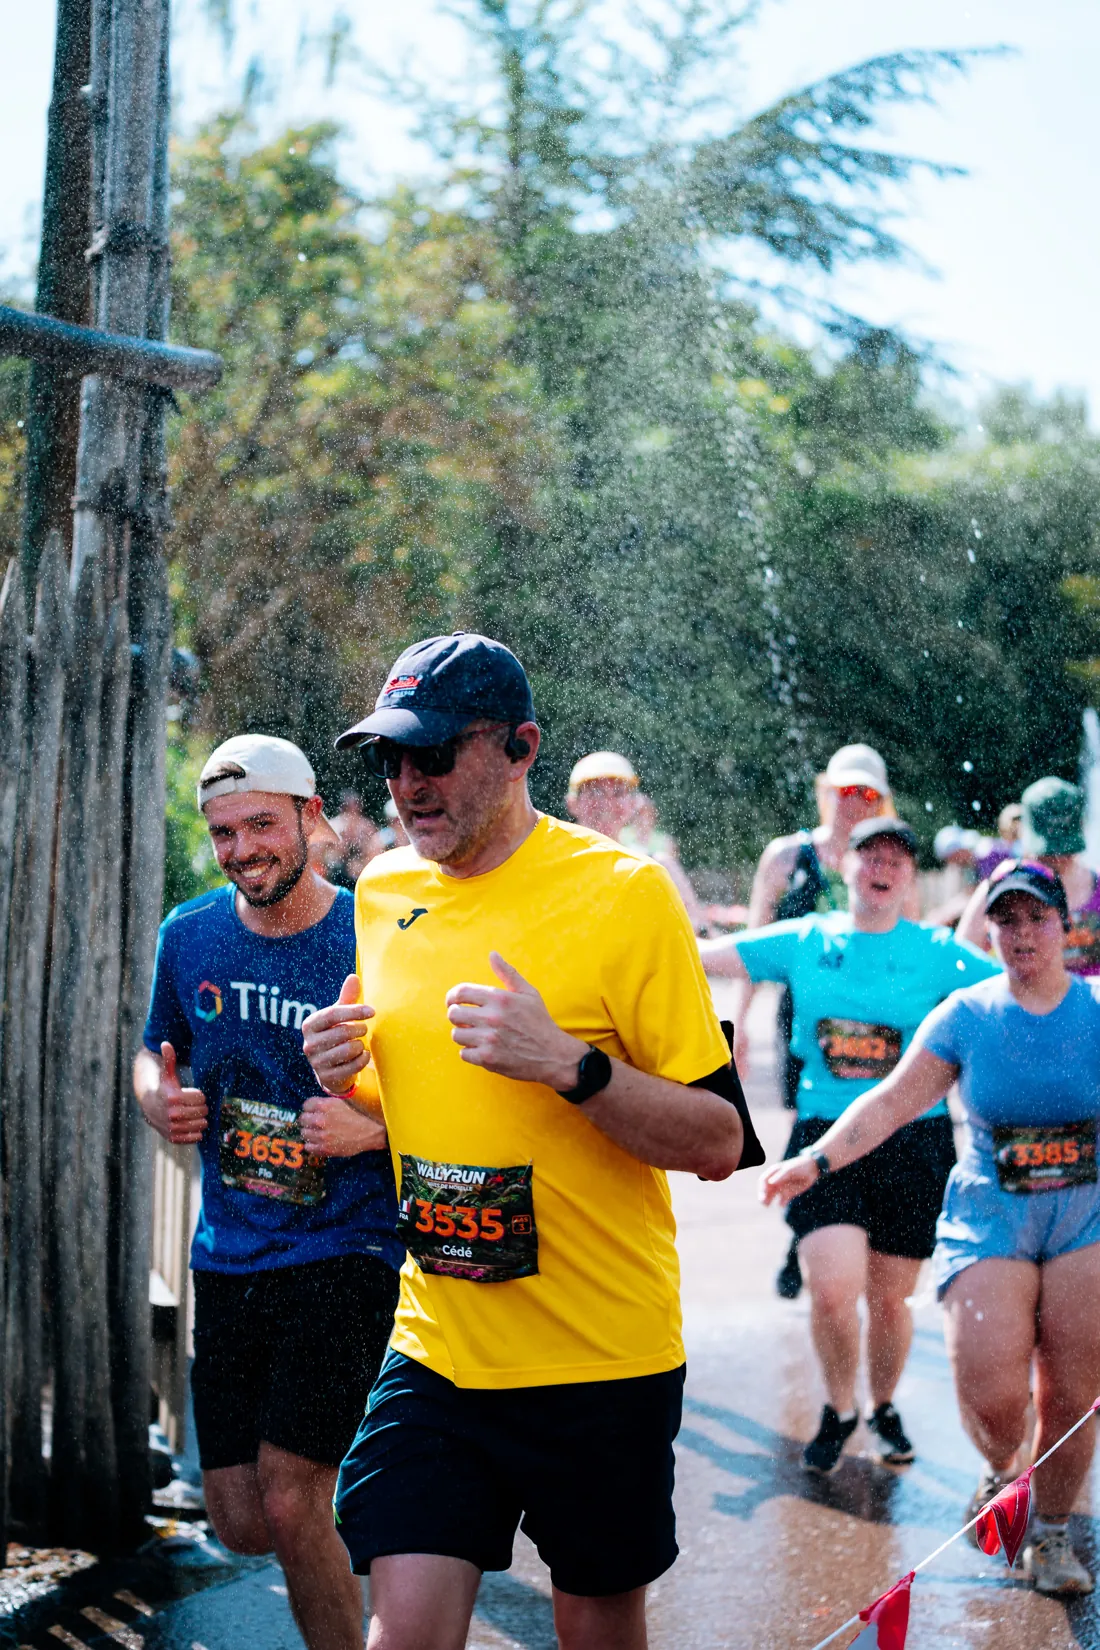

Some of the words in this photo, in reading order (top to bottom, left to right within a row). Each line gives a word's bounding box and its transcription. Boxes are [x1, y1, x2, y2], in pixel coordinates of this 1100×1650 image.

[241, 1101, 297, 1123] WALYRUN
[234, 1131, 305, 1169] 3653
[1012, 1140, 1079, 1166] 3385
[258, 1168, 273, 1179] Flo
[416, 1162, 486, 1185] WALYRUN
[399, 1212, 409, 1221] FRA
[415, 1199, 505, 1241] 3535
[442, 1244, 473, 1258] Cédé
